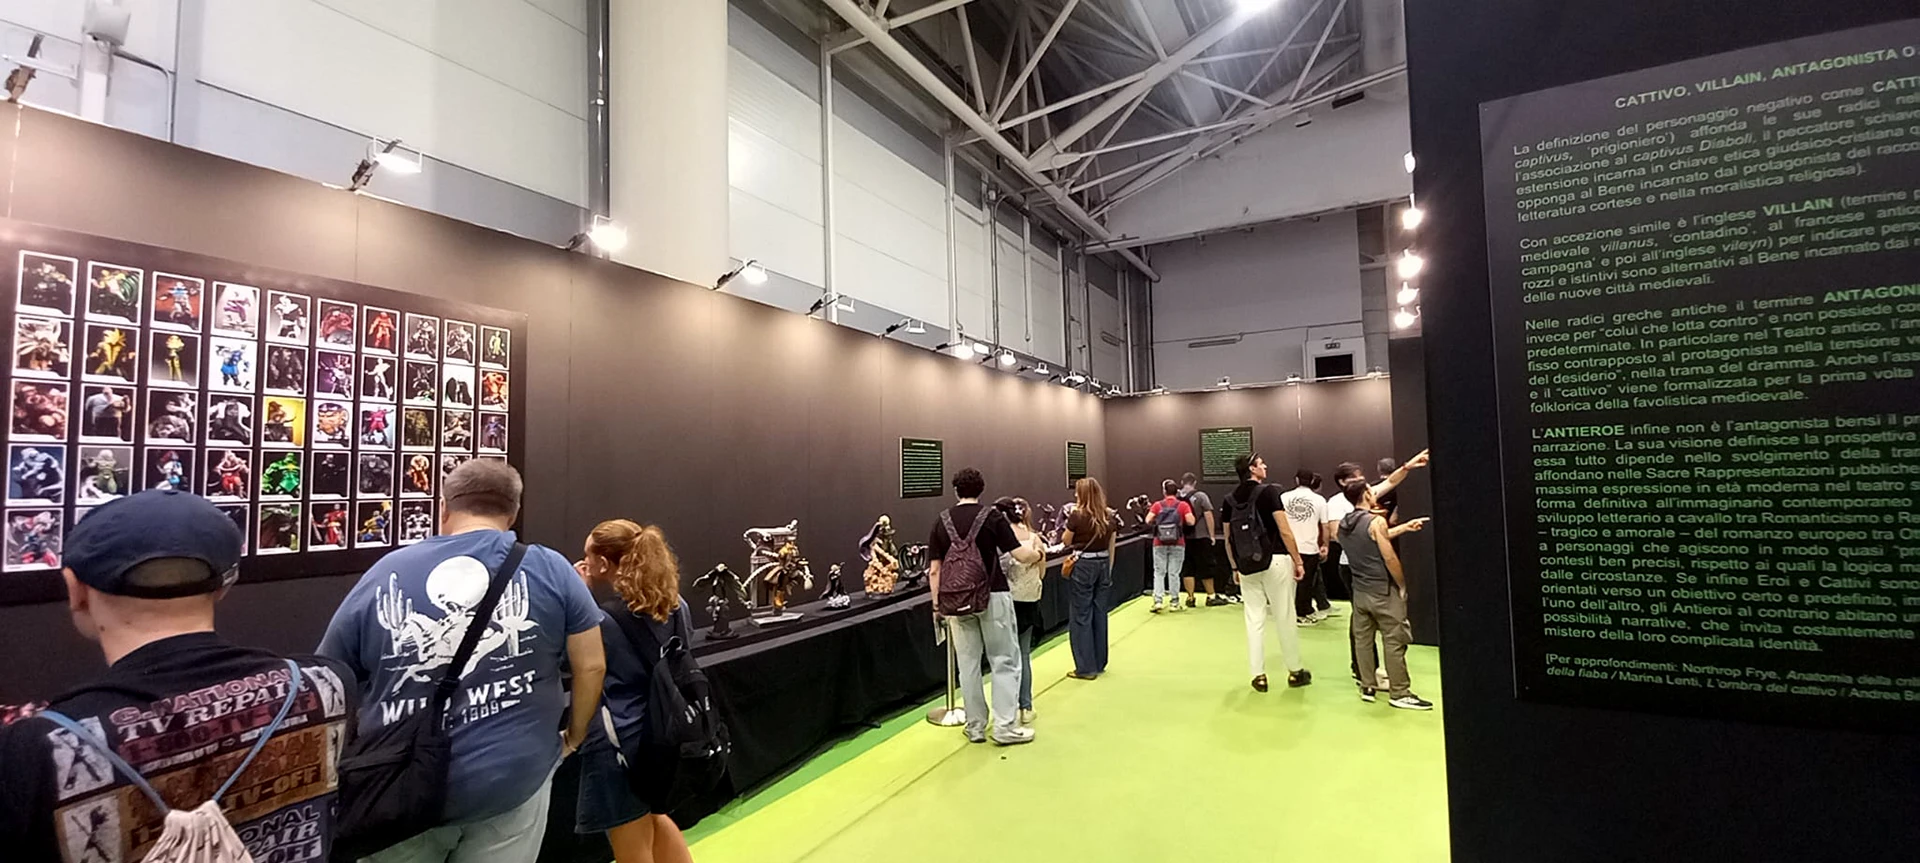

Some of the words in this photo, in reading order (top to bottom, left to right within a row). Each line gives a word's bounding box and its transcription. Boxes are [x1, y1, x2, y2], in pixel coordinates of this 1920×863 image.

[1772, 48, 1898, 81] ANTAGONISTA
[1902, 45, 1916, 58] O
[1536, 131, 1610, 152] definizione
[1646, 108, 1738, 135] personaggio
[1746, 95, 1814, 115] negativo
[1820, 86, 1864, 102] come
[1689, 120, 1747, 139] affonda
[1516, 176, 1589, 195] estensione
[1593, 167, 1646, 183] incarna
[1668, 156, 1718, 172] chiave
[1722, 149, 1760, 163] etica
[1765, 127, 1904, 159] giudaico-cristiana
[1632, 145, 1693, 162] captivus
[1516, 192, 1575, 210] opponga
[1597, 183, 1635, 197] Bene
[1639, 171, 1709, 191] incarnato
[1742, 151, 1841, 178] protagonista
[1517, 205, 1586, 223] letteratura
[1589, 196, 1642, 212] cortese
[1659, 187, 1696, 202] nella
[1699, 176, 1784, 196] moralistica
[1520, 237, 1546, 249] Con
[1552, 228, 1622, 245] accezione
[1628, 220, 1670, 235] simile
[1763, 199, 1833, 218] VILLAIN
[1520, 244, 1589, 263] medievale
[1522, 276, 1554, 290] rozzi
[1570, 269, 1617, 285] istintivi
[1621, 267, 1657, 279] sono
[1660, 256, 1734, 274] alternativi
[1757, 250, 1799, 263] Bene
[1804, 240, 1880, 258] incarnato
[1522, 290, 1555, 304] delle
[1558, 287, 1601, 300] nuove
[1525, 317, 1559, 330] Nelle
[1566, 313, 1604, 326] radici
[1612, 308, 1662, 325] greche
[1670, 302, 1727, 317] antiche
[1752, 296, 1814, 310] termine
[1526, 332, 1569, 344] invece
[1641, 322, 1668, 334] che
[1672, 319, 1704, 332] lotta
[1782, 312, 1813, 323] non
[1818, 304, 1892, 322] possiede
[1658, 332, 1738, 349] particolare
[1773, 325, 1826, 338] Teatro
[1527, 360, 1559, 371] fisso
[1563, 352, 1656, 368] contrapposto
[1680, 344, 1778, 363] protagonista
[1784, 340, 1823, 353] nella
[1829, 337, 1900, 350] tensione
[1630, 366, 1665, 379] nella
[1670, 365, 1714, 376] trama
[1824, 353, 1878, 367] Anche
[1617, 382, 1657, 394] viene
[1663, 376, 1757, 391] formalizzata
[1819, 371, 1866, 385] prima
[1530, 400, 1590, 412] folklorica
[1594, 397, 1629, 409] della
[1632, 394, 1707, 407] favolistica
[1630, 423, 1670, 435] infine
[1676, 423, 1704, 433] non
[1637, 440, 1664, 449] sua
[1668, 437, 1722, 448] visione
[1727, 434, 1800, 446] definisce
[1824, 430, 1916, 446] prospettiva
[1533, 457, 1566, 466] essa
[1574, 454, 1606, 465] tutto
[1615, 452, 1674, 466] dipende
[1684, 451, 1721, 462] nello
[1731, 449, 1830, 463] svolgimento
[1840, 448, 1880, 459] della
[1534, 468, 1604, 480] affondano
[1607, 467, 1642, 479] nelle
[1646, 468, 1690, 478] Sacre
[1694, 464, 1834, 479] Rappresentazioni
[1535, 483, 1597, 494] massima
[1602, 482, 1691, 496] espressione
[1746, 481, 1819, 492] moderna
[1856, 480, 1904, 491] teatro
[1536, 498, 1575, 508] forma
[1583, 497, 1647, 508] definitiva
[1781, 496, 1912, 509] contemporaneo
[1537, 512, 1594, 525] sviluppo
[1597, 512, 1661, 522] letterario
[1677, 512, 1732, 522] cavallo
[1761, 512, 1879, 522] Romanticismo
[1550, 526, 1598, 539] tragico
[1615, 526, 1675, 537] amorale
[1722, 529, 1793, 538] romanzo
[1798, 530, 1867, 541] europeo
[1555, 541, 1634, 554] personaggi
[1642, 541, 1669, 552] che
[1678, 542, 1749, 555] agiscono
[1782, 544, 1829, 555] modo
[1539, 554, 1593, 565] contesti
[1690, 557, 1749, 571] rispetto
[1843, 560, 1892, 574] logica
[1540, 568, 1573, 580] dalle
[1706, 573, 1748, 584] infine
[1757, 574, 1790, 585] Eroi
[1818, 576, 1871, 587] Cattivi
[1541, 583, 1596, 595] orientati
[1601, 586, 1641, 596] verso
[1670, 587, 1736, 599] obiettivo
[1672, 602, 1732, 614] Antieroi
[1757, 606, 1829, 618] contrario
[1544, 625, 1595, 638] mistero
[1599, 627, 1634, 640] della
[1638, 629, 1666, 641] loro
[1670, 633, 1754, 646] complicata
[1700, 618, 1729, 630] che
[1739, 620, 1782, 632] invita
[1792, 624, 1914, 639] costantemente
[466, 669, 536, 706] WEST
[117, 715, 175, 742] TV
